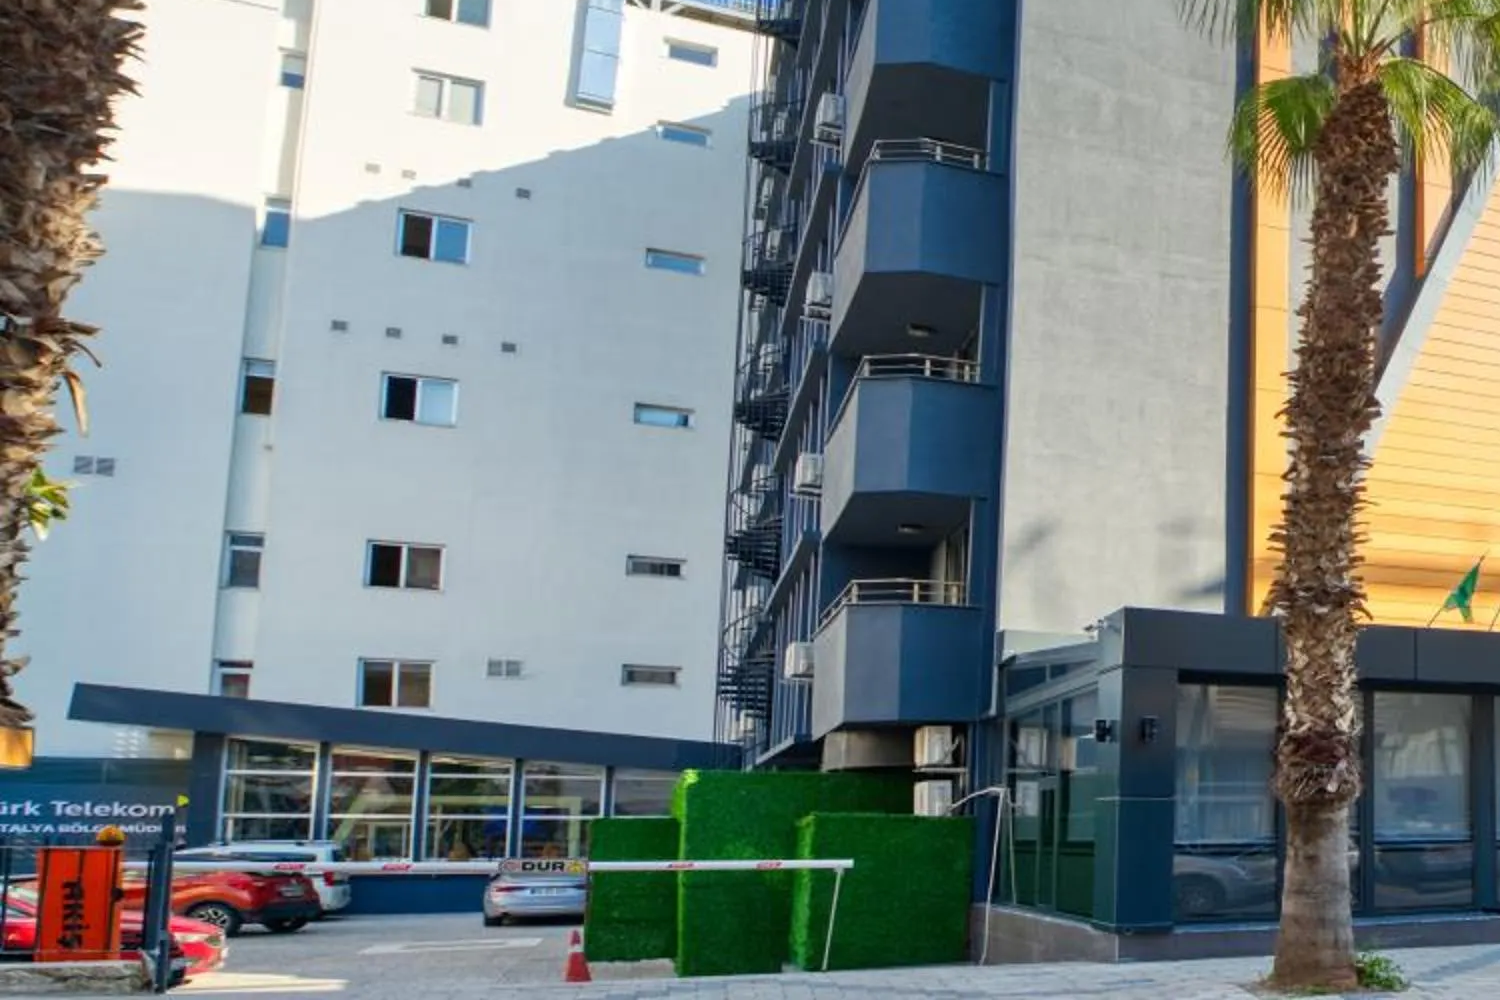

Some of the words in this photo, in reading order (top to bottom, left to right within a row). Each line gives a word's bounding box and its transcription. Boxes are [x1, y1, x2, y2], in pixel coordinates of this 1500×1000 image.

[0, 800, 41, 816] ürk
[51, 800, 175, 817] Telekom
[0, 823, 55, 834] TALYA
[521, 861, 566, 872] DUR
